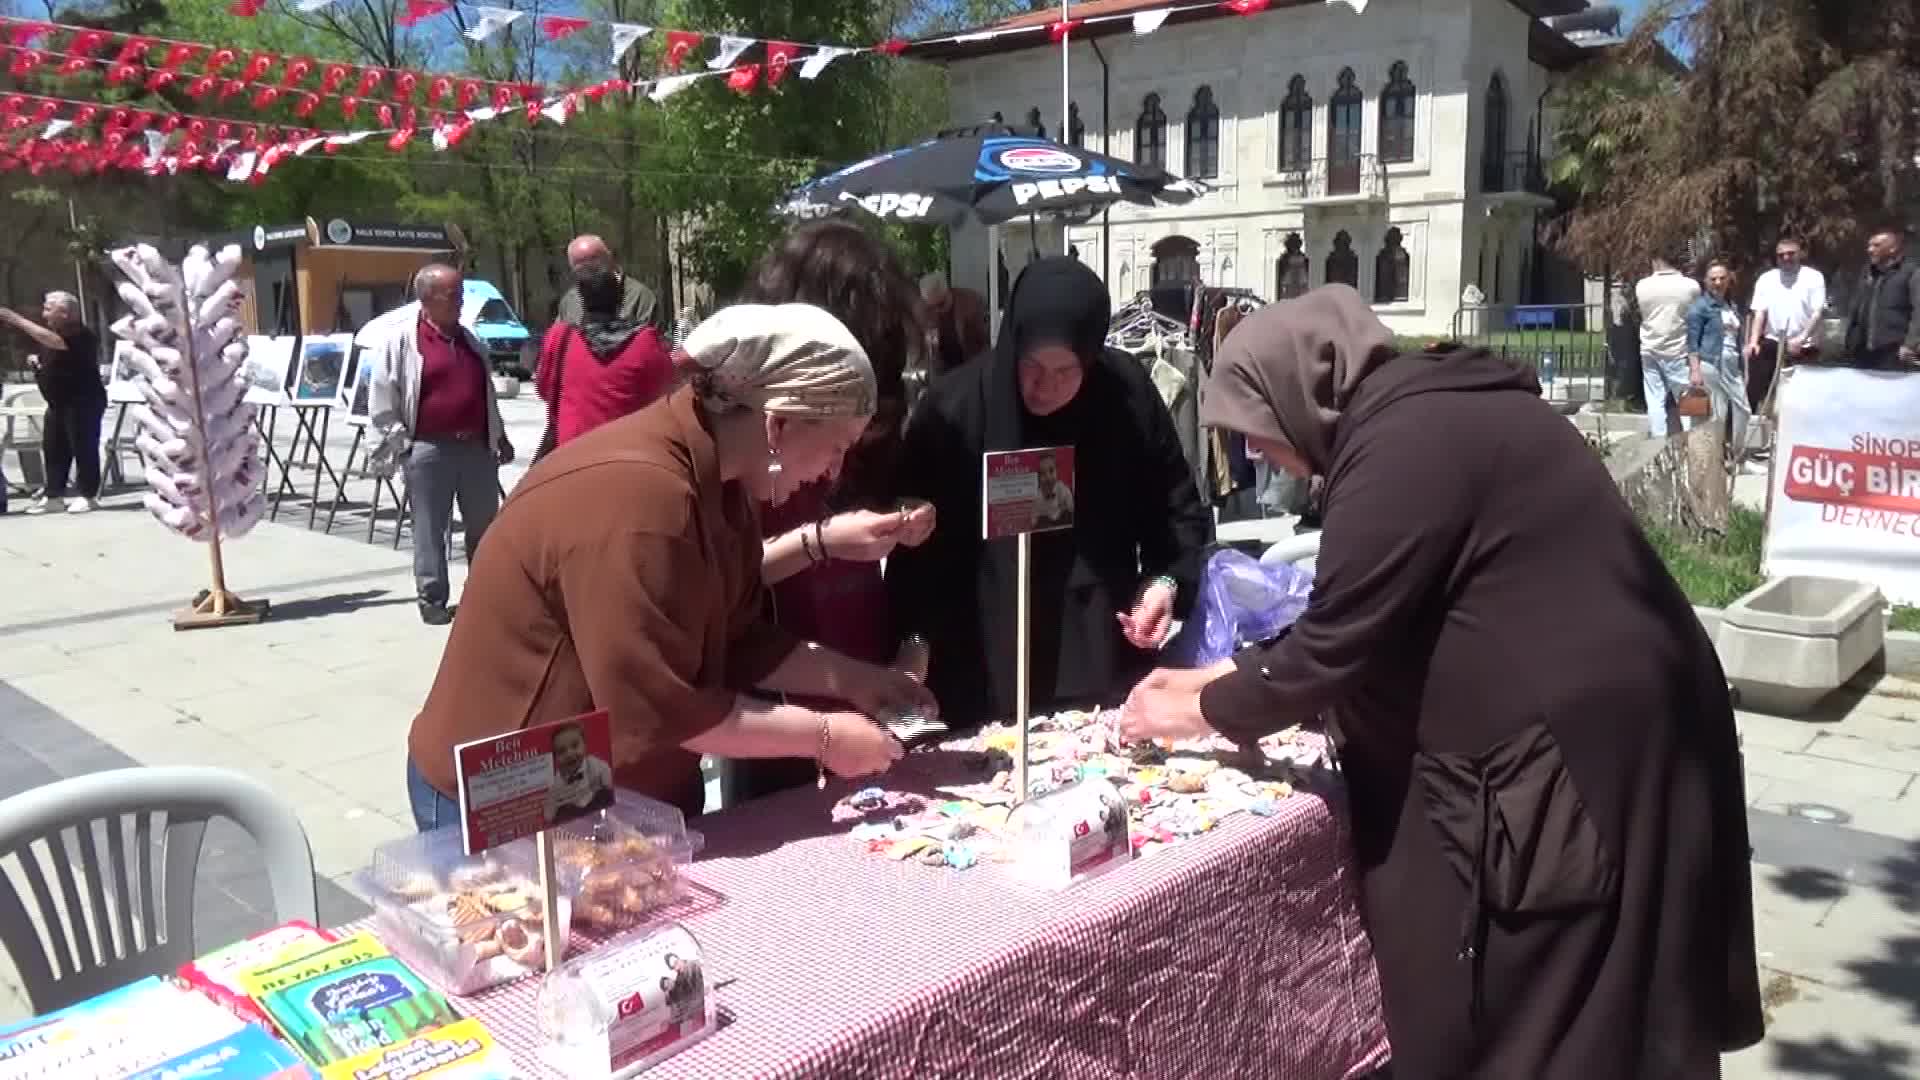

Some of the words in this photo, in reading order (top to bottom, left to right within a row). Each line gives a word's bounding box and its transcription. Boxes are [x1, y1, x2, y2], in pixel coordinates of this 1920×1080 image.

[1011, 175, 1122, 206] PEPSI
[1851, 432, 1920, 460] SİNOP
[1791, 453, 1855, 497] GÜÇ
